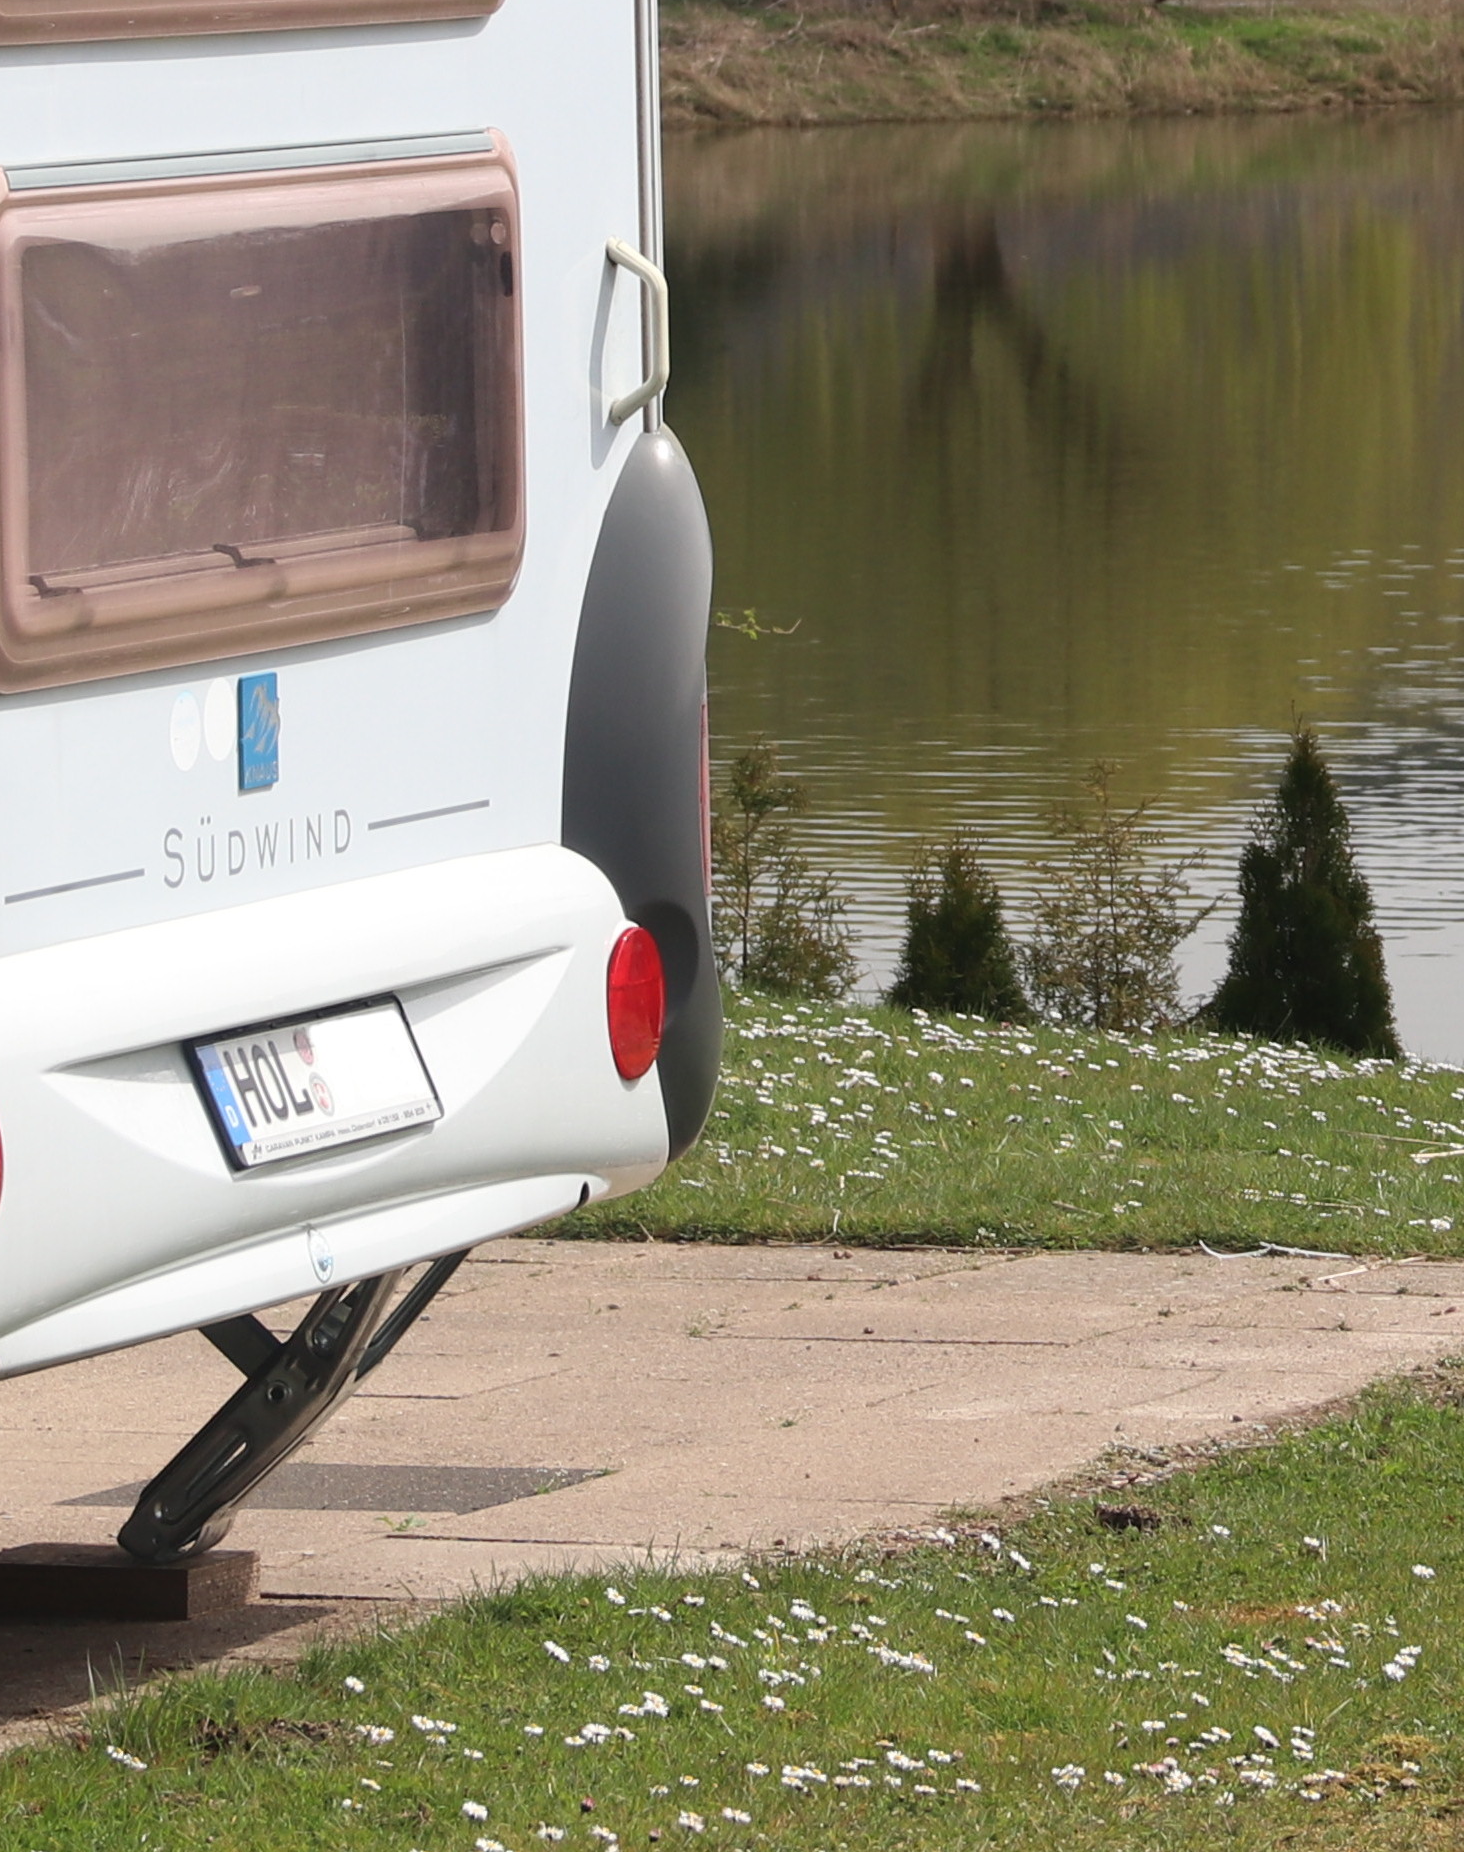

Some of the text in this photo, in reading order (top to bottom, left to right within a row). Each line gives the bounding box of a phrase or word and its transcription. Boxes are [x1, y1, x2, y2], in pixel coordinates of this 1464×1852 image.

[163, 809, 352, 888] SÜDWIND
[223, 1040, 314, 1128] HOL
[225, 1105, 238, 1128] D
